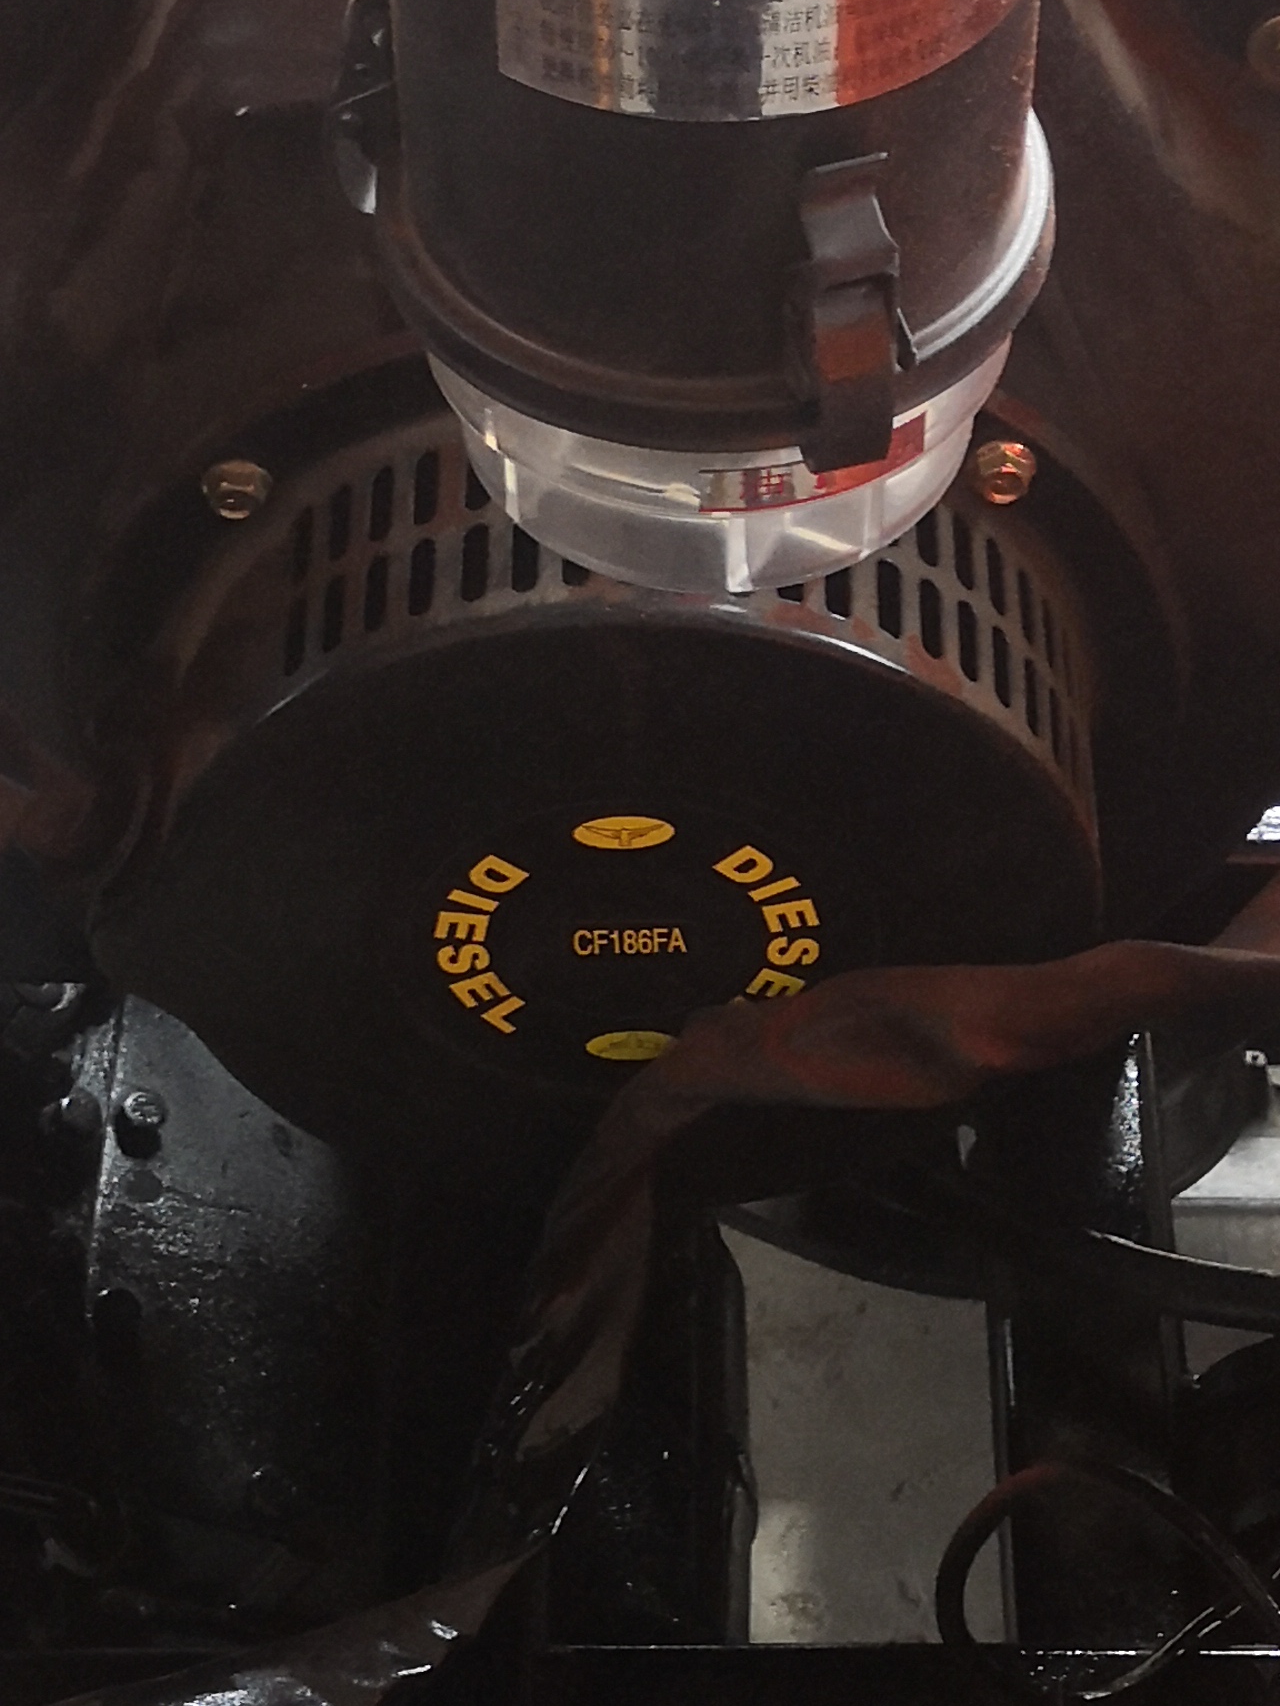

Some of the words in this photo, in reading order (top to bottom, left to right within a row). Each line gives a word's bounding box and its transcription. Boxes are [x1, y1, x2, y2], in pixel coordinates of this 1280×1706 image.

[433, 853, 531, 1035] DIESEL
[572, 927, 688, 956] CF186FA
[711, 844, 821, 1006] DIESE
